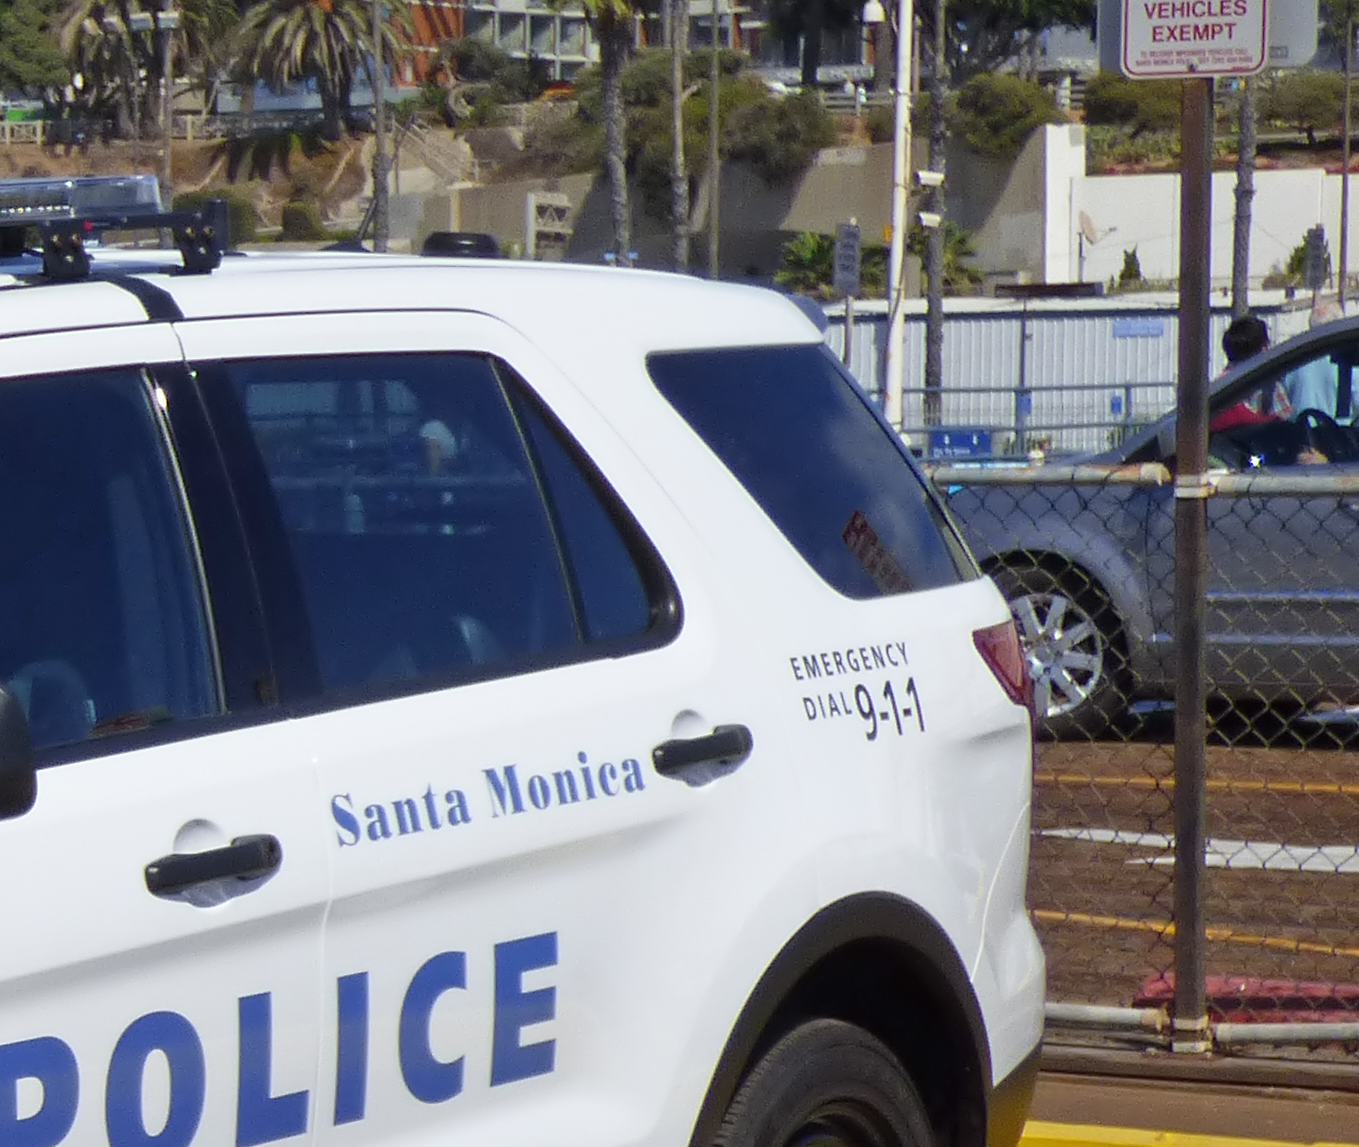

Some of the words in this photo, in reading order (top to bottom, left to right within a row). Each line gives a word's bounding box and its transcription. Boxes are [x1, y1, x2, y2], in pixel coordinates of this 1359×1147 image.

[1144, 0, 1248, 19] VEHICLES
[1152, 23, 1237, 42] EXEMPT
[789, 641, 909, 681] EMERGENCY
[801, 691, 853, 721] DIAL
[854, 676, 925, 741] 9-1-1
[331, 783, 472, 848] Santa
[481, 750, 646, 818] Monica
